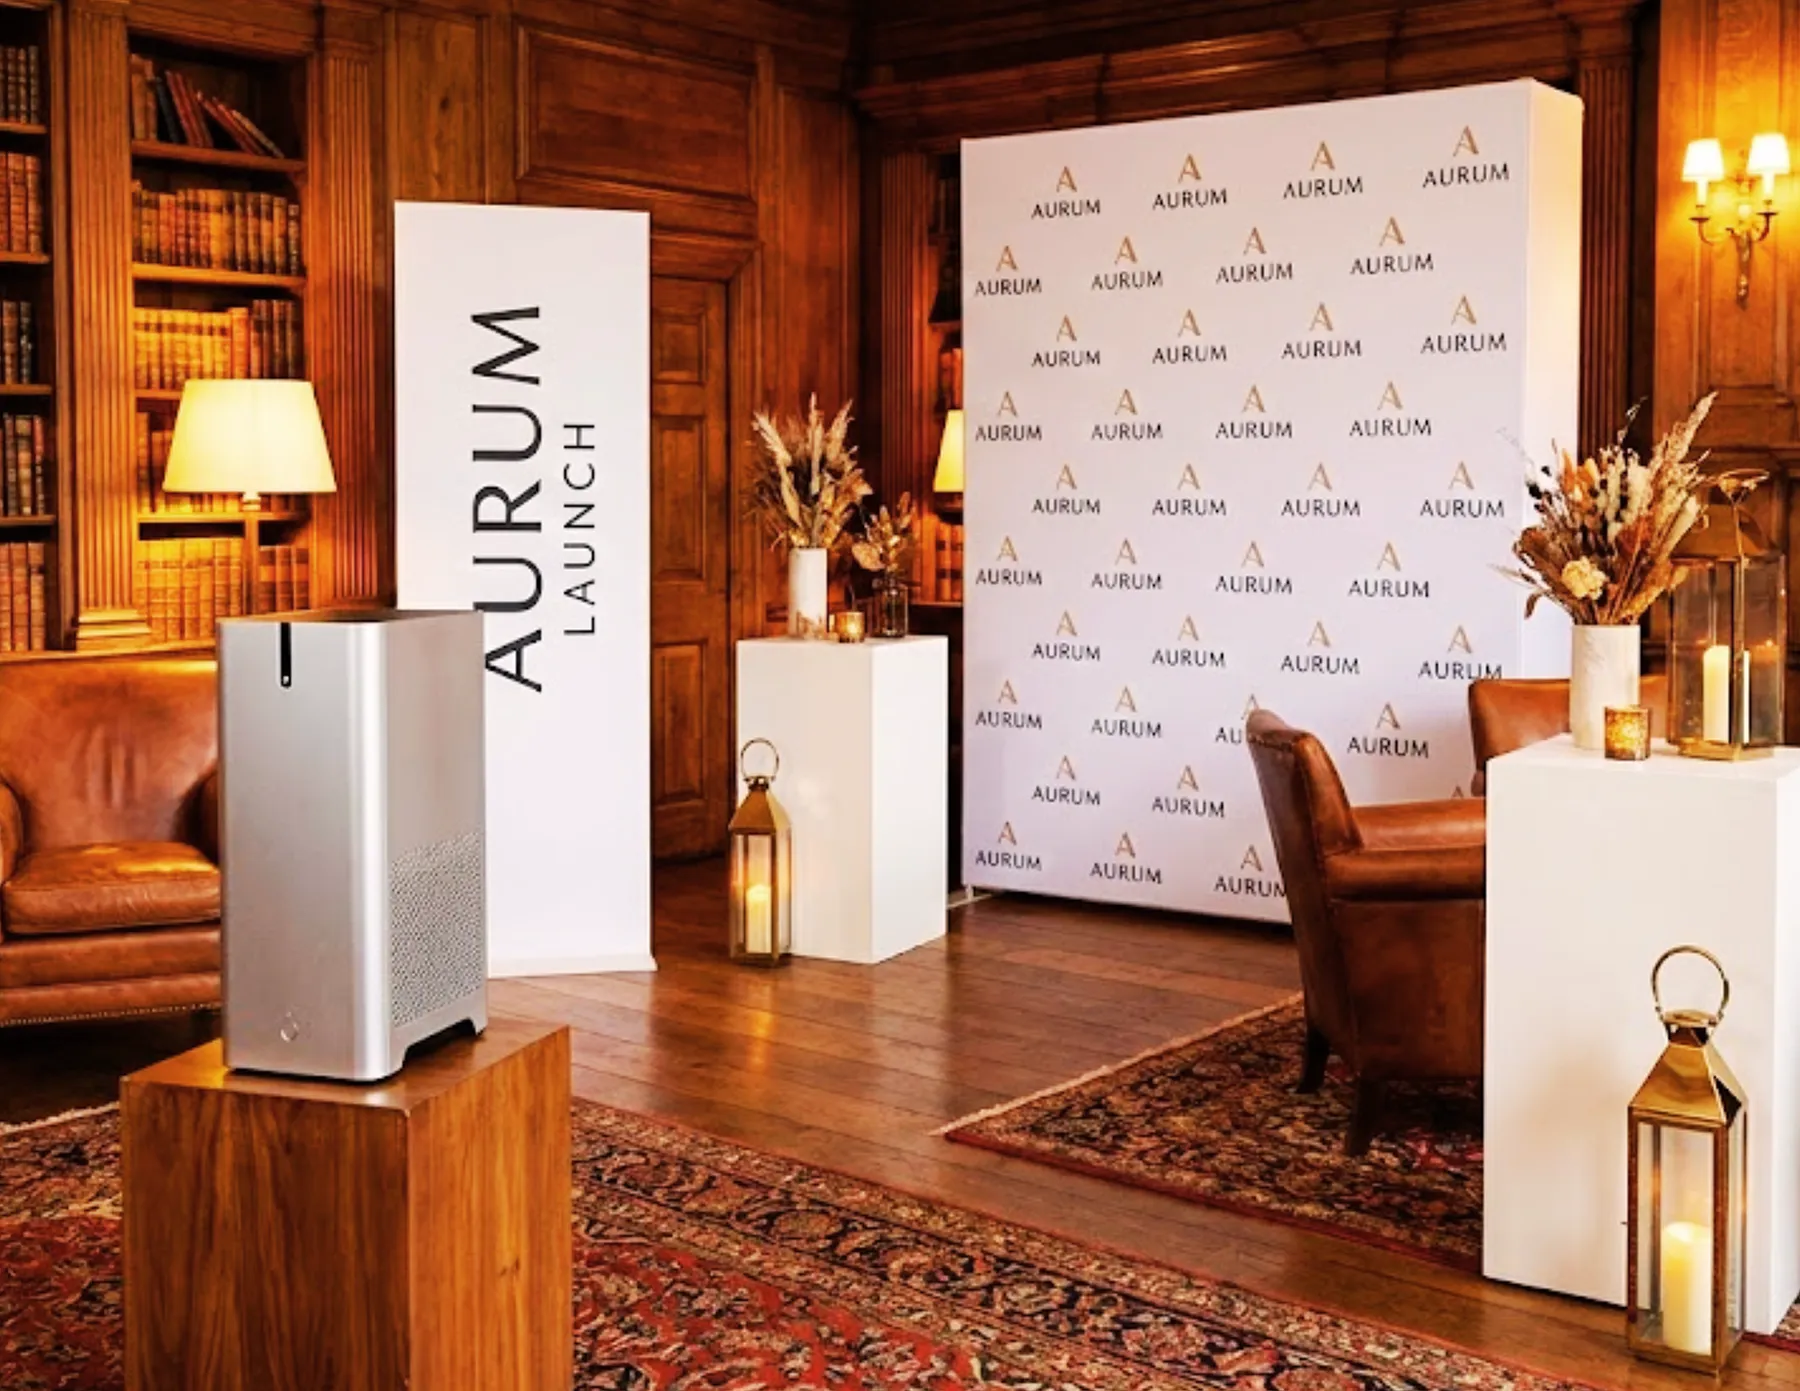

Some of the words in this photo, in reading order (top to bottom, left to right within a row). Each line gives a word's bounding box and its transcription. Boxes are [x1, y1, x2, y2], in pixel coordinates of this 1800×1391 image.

[1422, 162, 1509, 188] AURUM
[1283, 176, 1363, 199] AURUM
[1153, 188, 1227, 210] AURUM
[1031, 200, 1100, 218] AURUM
[1216, 263, 1292, 283] AURUM
[1350, 253, 1433, 275] AURUM
[976, 278, 1042, 296] AURUM
[1092, 271, 1163, 290] AURUM
[1282, 340, 1361, 359] AURUM
[1420, 332, 1506, 354] AURUM
[1031, 351, 1100, 367] AURUM
[1152, 345, 1227, 364] AURUM
[976, 425, 1042, 441] AURUM
[1092, 423, 1163, 440] AURUM
[1216, 422, 1292, 438] AURUM
[1349, 418, 1431, 436] AURUM
[471, 306, 543, 693] AURUM
[1032, 498, 1100, 515] AURUM
[1152, 499, 1226, 516] AURUM
[1281, 499, 1360, 517] AURUM
[1420, 499, 1504, 518] AURUM
[563, 423, 596, 635] LAUNCH
[976, 569, 1042, 586] AURUM
[1092, 573, 1161, 590] AURUM
[1216, 576, 1292, 594] AURUM
[1349, 579, 1429, 598] AURUM
[1033, 643, 1100, 661] AURUM
[1152, 649, 1225, 667] AURUM
[1281, 655, 1360, 674] AURUM
[975, 711, 1042, 729] AURUM
[1092, 719, 1161, 738] AURUM
[1348, 737, 1429, 759] AURUM
[1032, 786, 1100, 805] AURUM
[1152, 797, 1225, 818] AURUM
[976, 850, 1041, 870] AURUM
[1090, 863, 1162, 884] AURUM
